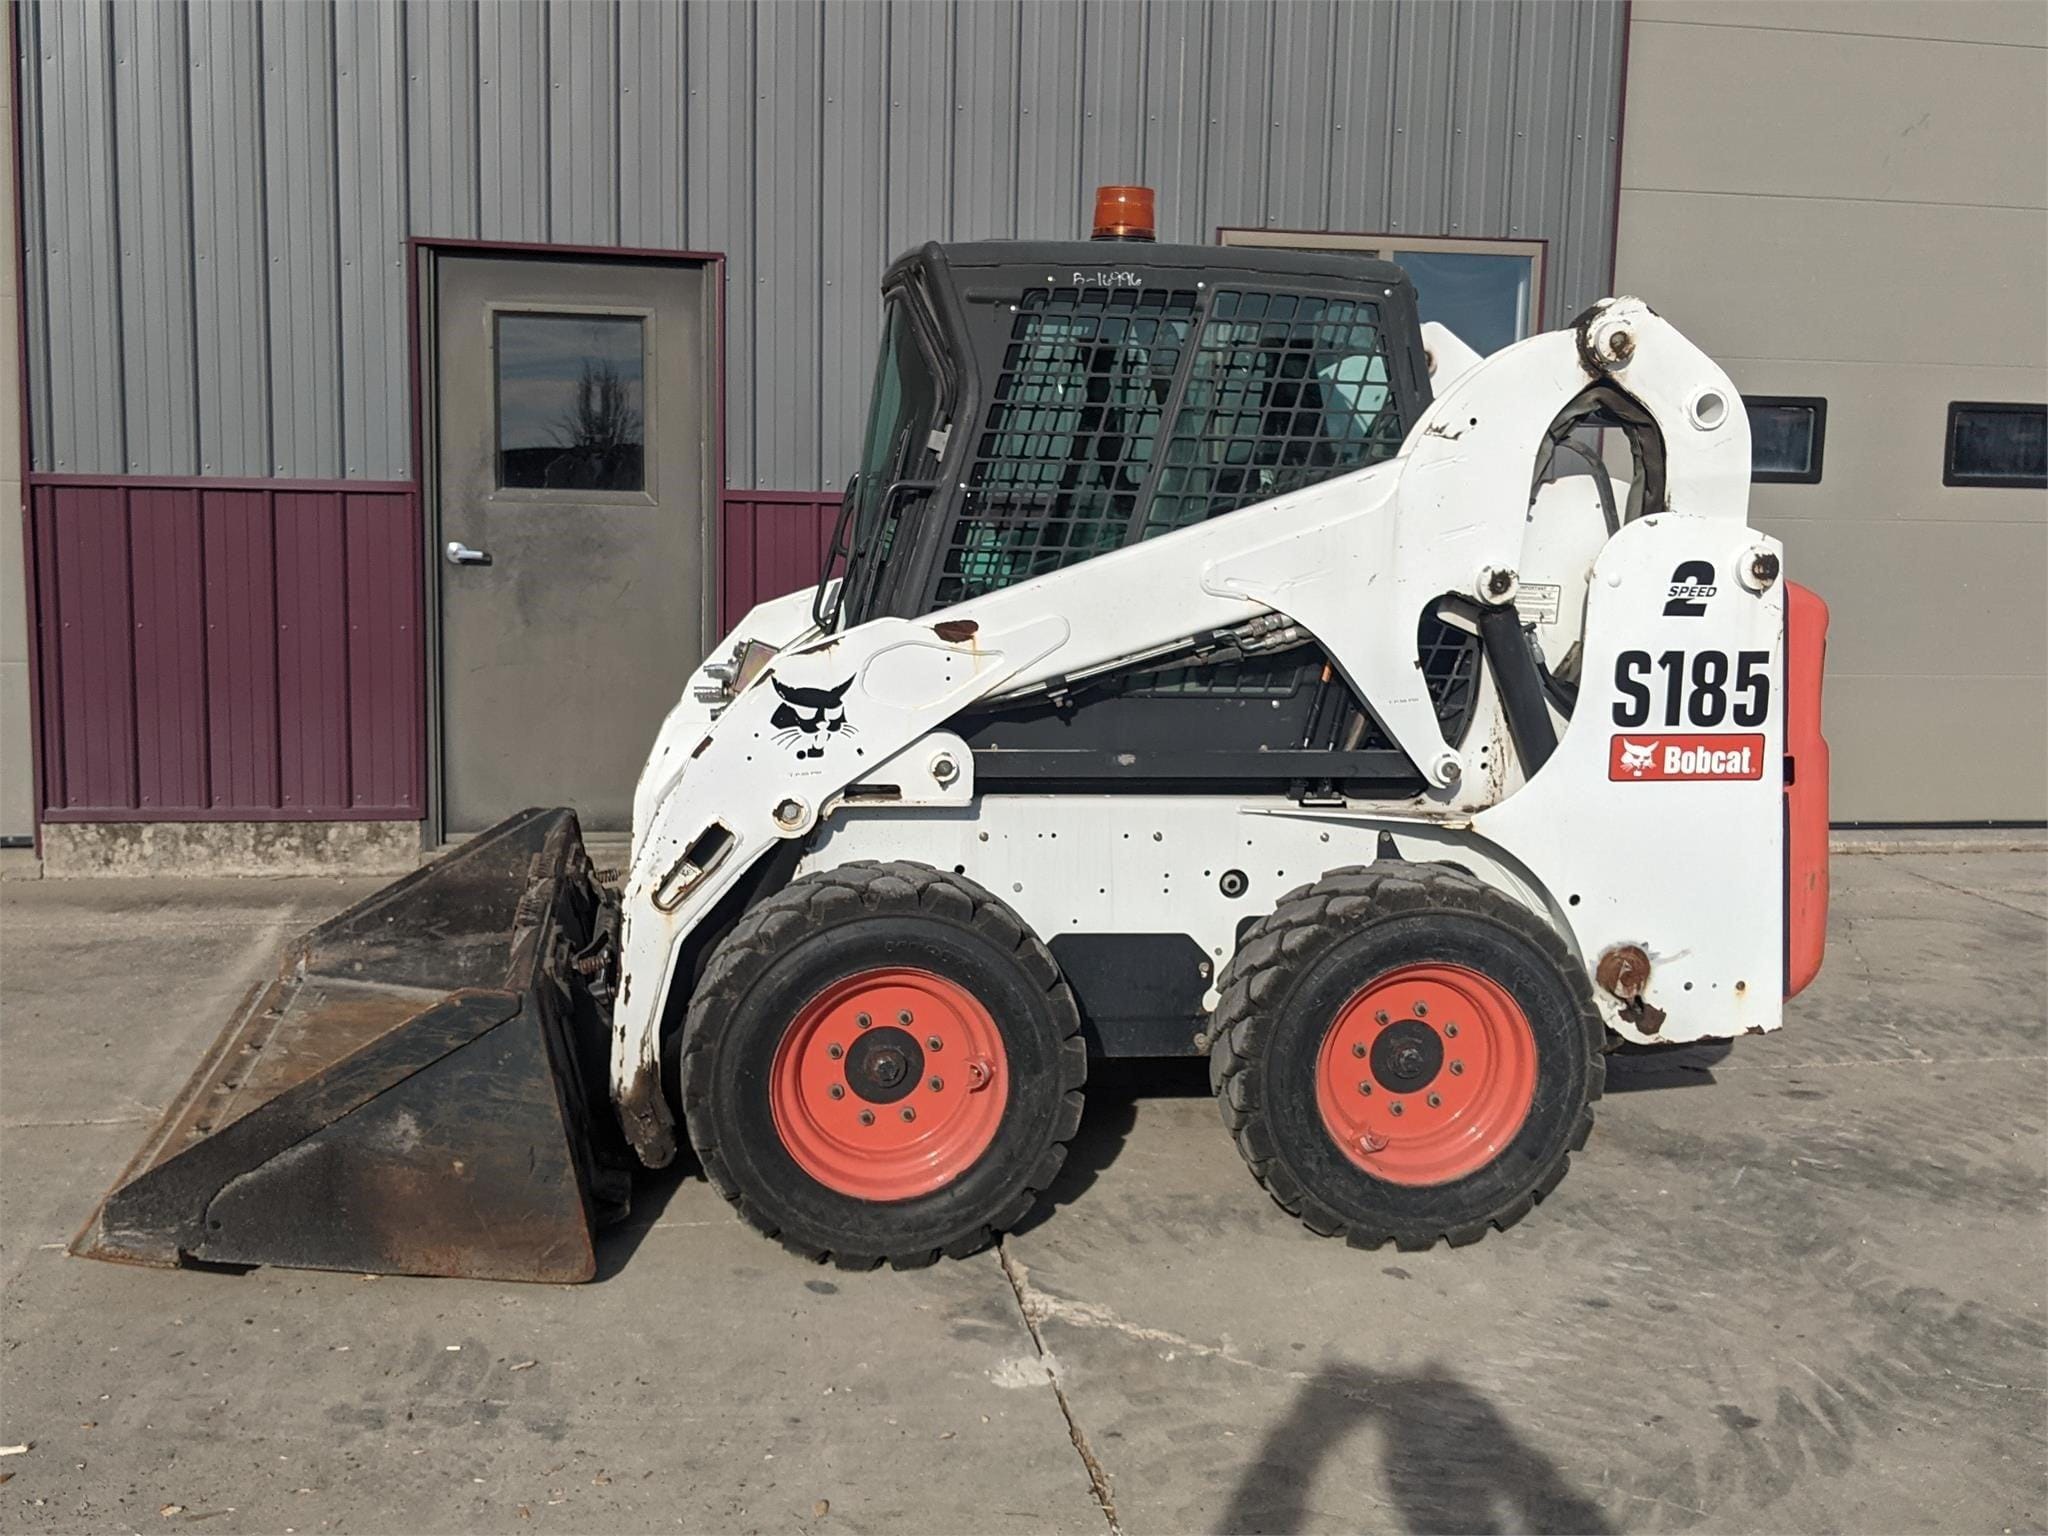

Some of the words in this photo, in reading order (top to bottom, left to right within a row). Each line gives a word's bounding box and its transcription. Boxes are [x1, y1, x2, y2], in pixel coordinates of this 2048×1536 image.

[1662, 560, 1716, 617] 2
[1667, 585, 1718, 598] SPEED
[1612, 650, 1770, 728] S185
[1663, 745, 1751, 774] Bobcat
